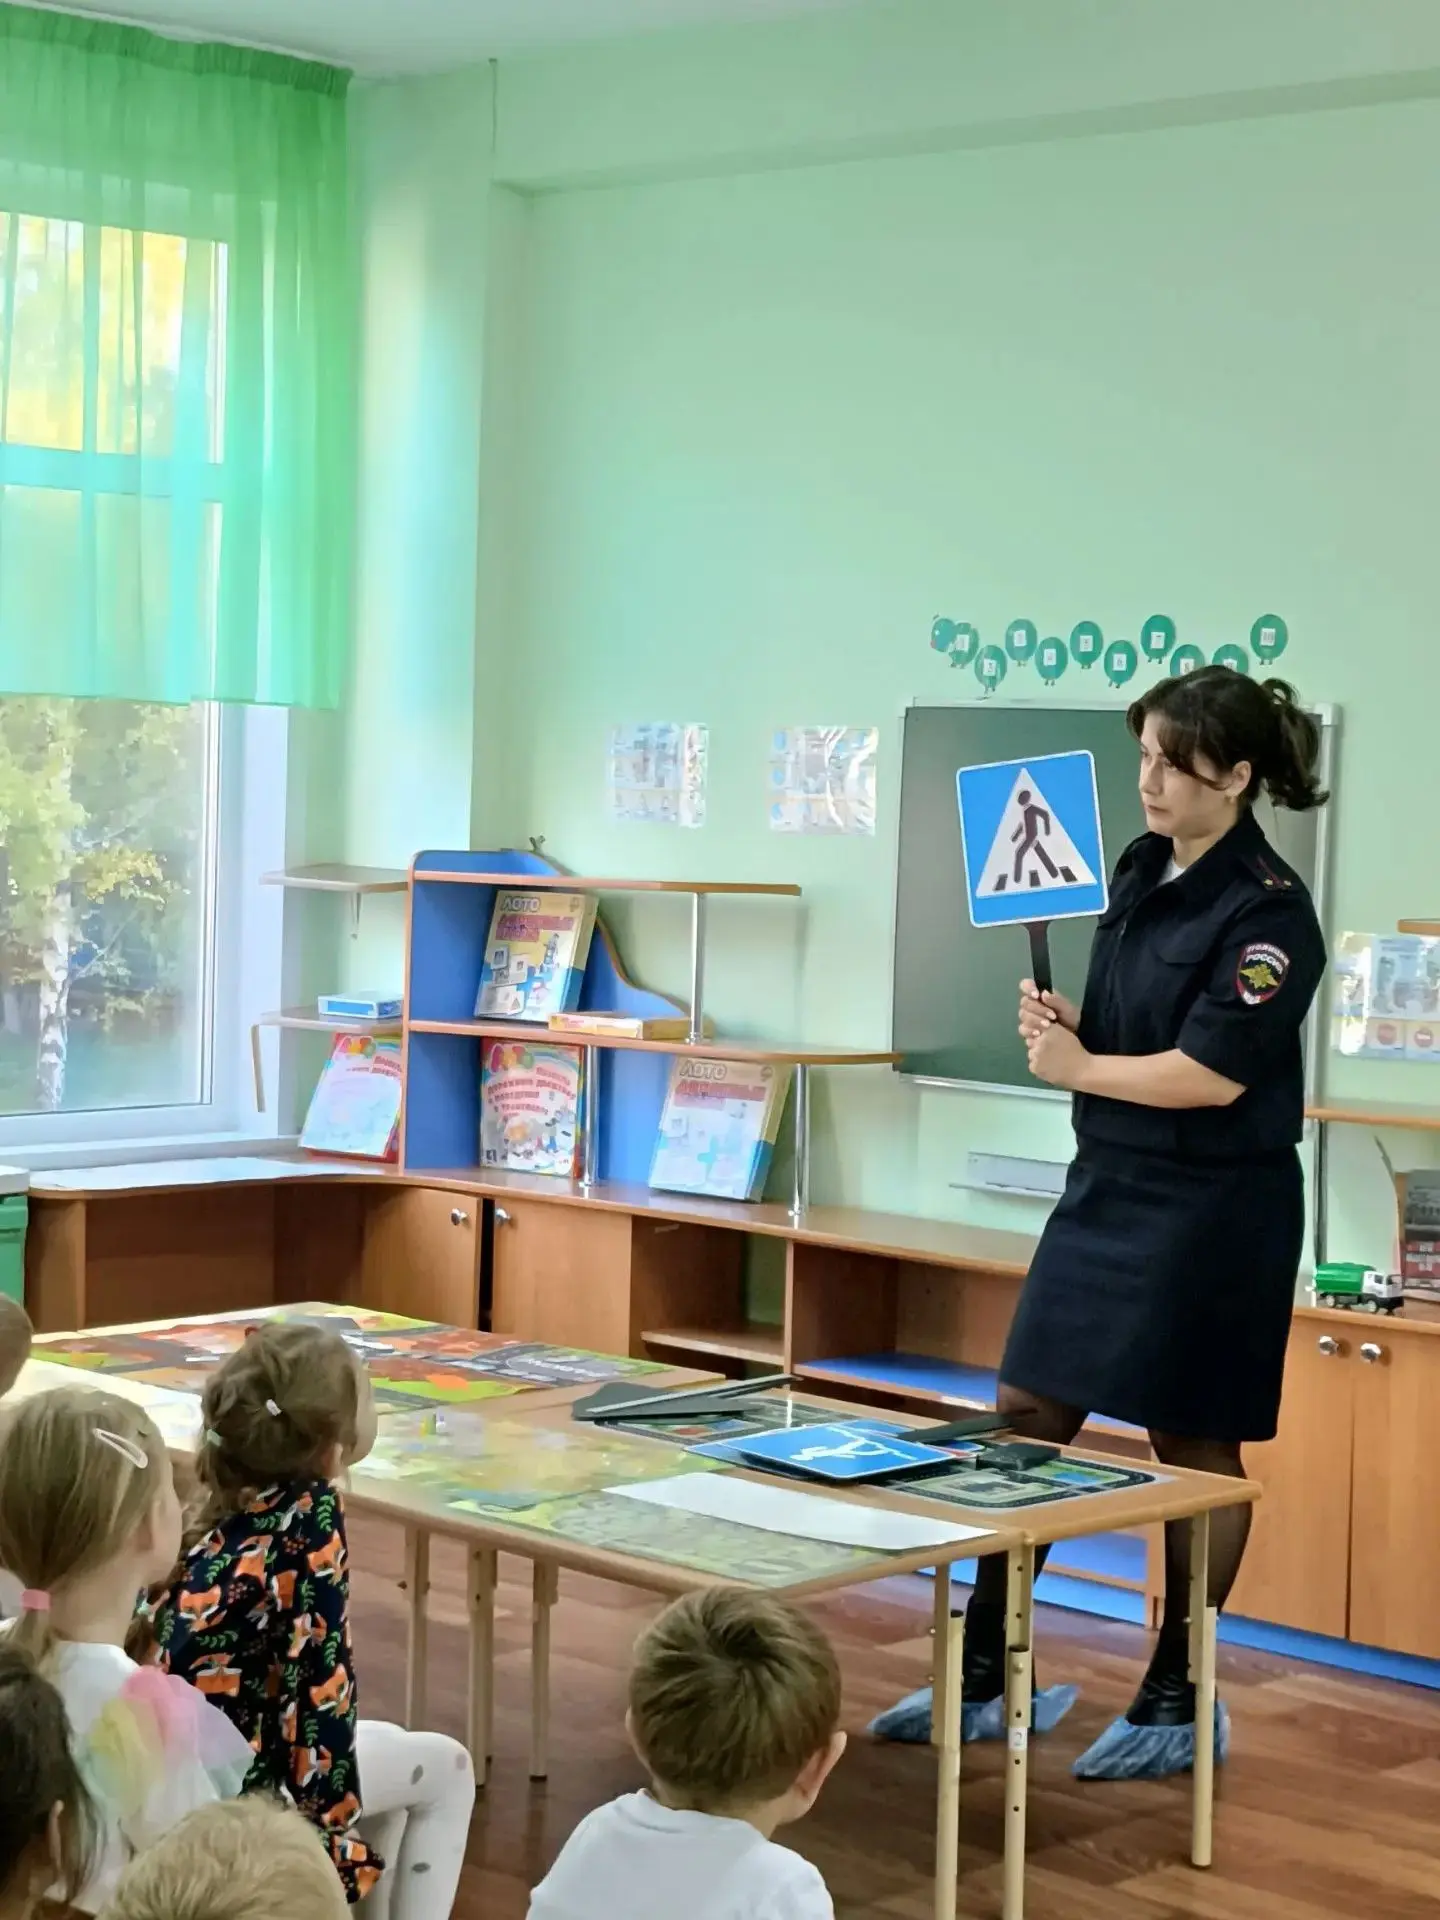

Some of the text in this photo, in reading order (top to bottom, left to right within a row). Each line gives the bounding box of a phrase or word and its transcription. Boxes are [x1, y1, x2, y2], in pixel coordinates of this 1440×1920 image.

[501, 896, 542, 913] ЛОТО
[679, 1059, 727, 1080] ЛОТО
[1014, 1732, 1024, 1747] 2
